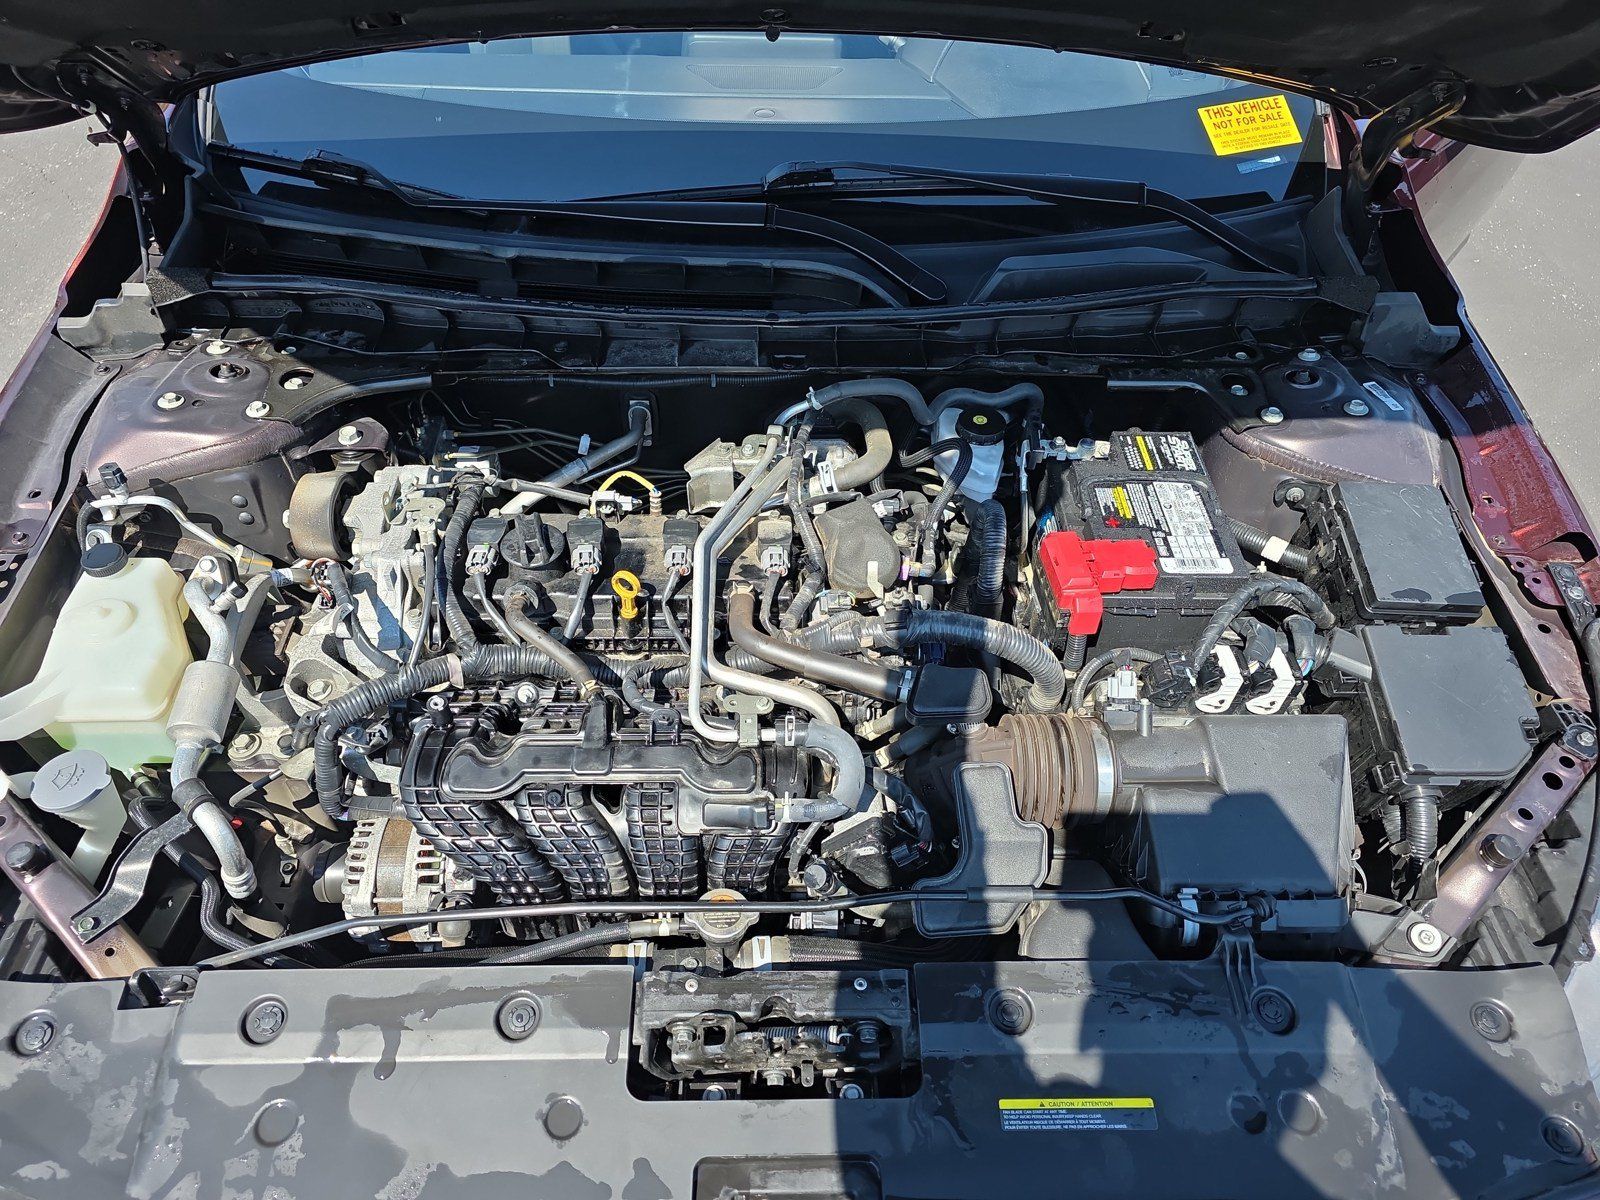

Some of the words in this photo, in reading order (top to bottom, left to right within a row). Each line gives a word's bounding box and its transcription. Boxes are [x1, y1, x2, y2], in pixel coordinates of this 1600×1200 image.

[1204, 106, 1233, 119] THIS
[1233, 98, 1282, 114] VEHICLE
[1212, 120, 1233, 130] NOT
[1236, 116, 1257, 126] FOR
[1259, 111, 1284, 122] SALE
[1167, 435, 1189, 471] START
[1180, 439, 1197, 471] SUPER
